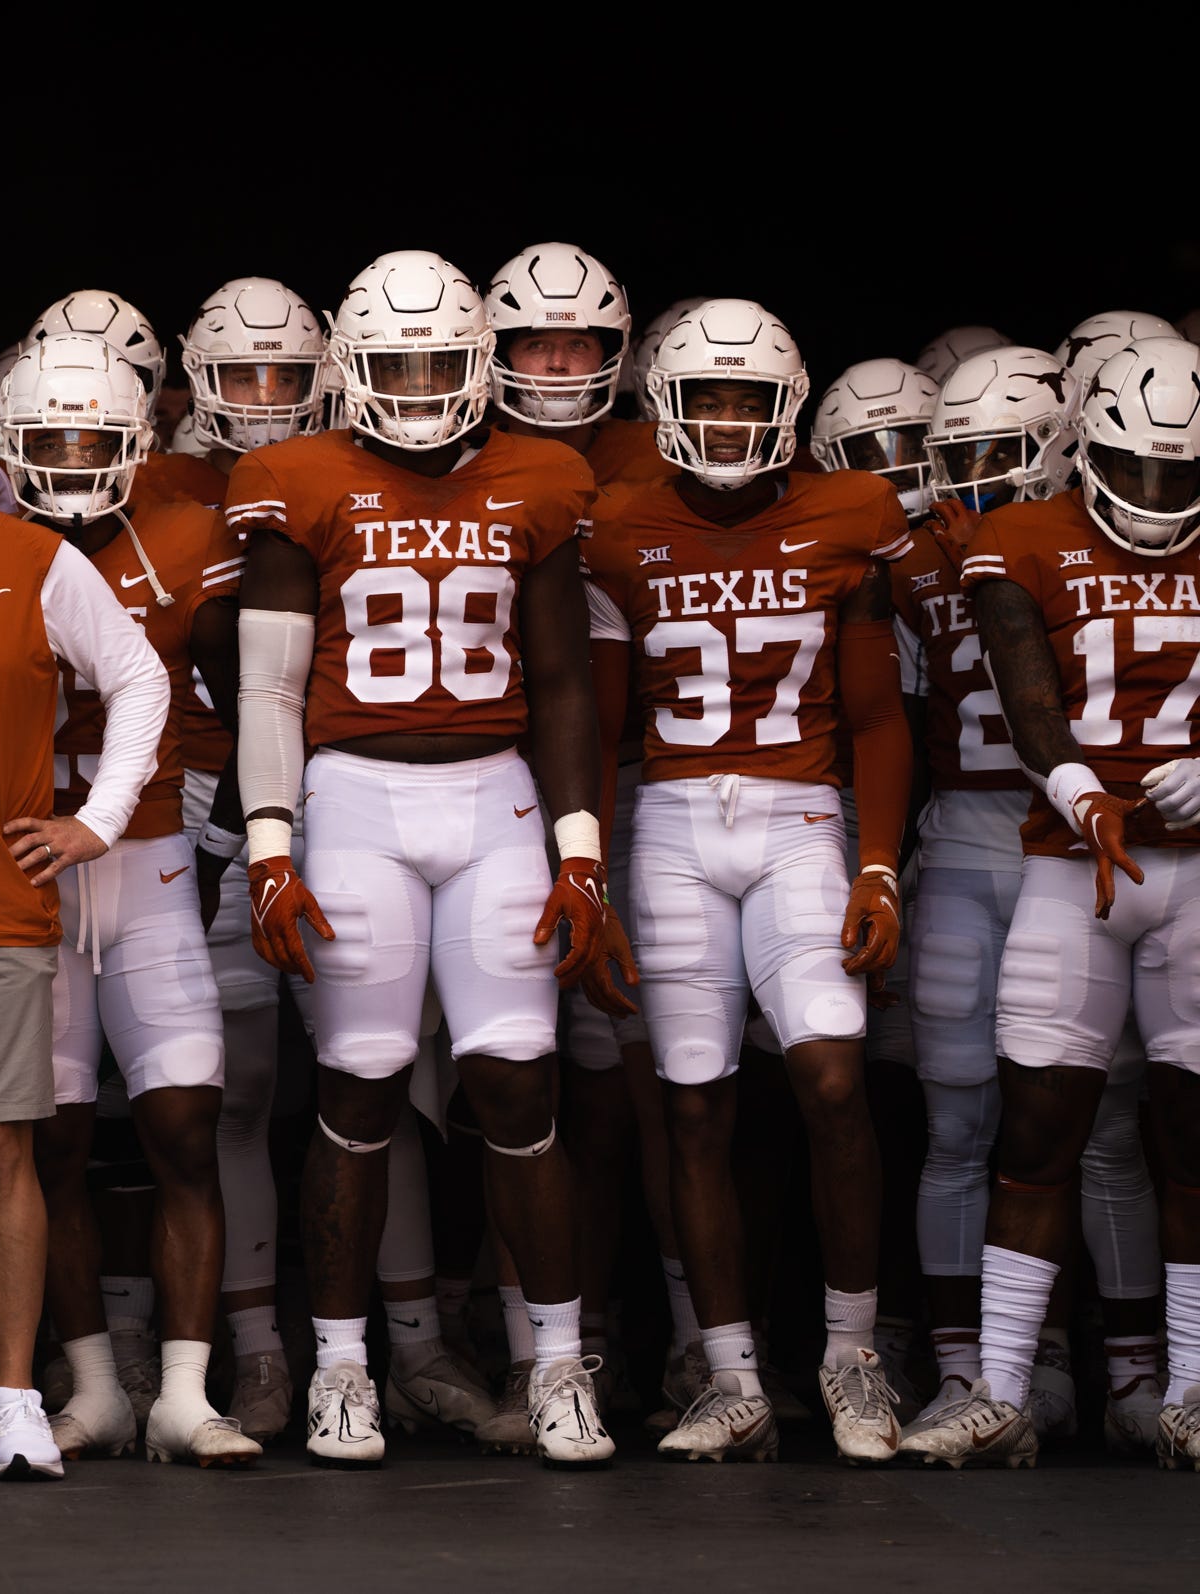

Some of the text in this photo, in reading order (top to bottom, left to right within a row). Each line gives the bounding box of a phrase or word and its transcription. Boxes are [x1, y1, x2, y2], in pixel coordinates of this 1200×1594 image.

[546, 312, 577, 321] HORNS
[401, 327, 432, 337] HORNS
[253, 341, 282, 351] HORNS
[714, 356, 745, 366] HORNS
[867, 406, 897, 418] HORNS
[944, 417, 970, 428] HORNS
[1151, 442, 1184, 454] HORNS
[350, 493, 383, 510] XII
[355, 520, 512, 562] TEXAS
[638, 545, 673, 565] XII
[1059, 548, 1094, 569] XII
[911, 569, 939, 592] XII
[648, 569, 808, 617] TEXAS
[1066, 574, 1200, 616] TEXA
[340, 567, 515, 703] 88
[644, 611, 825, 746] 37
[1070, 616, 1200, 746] 17
